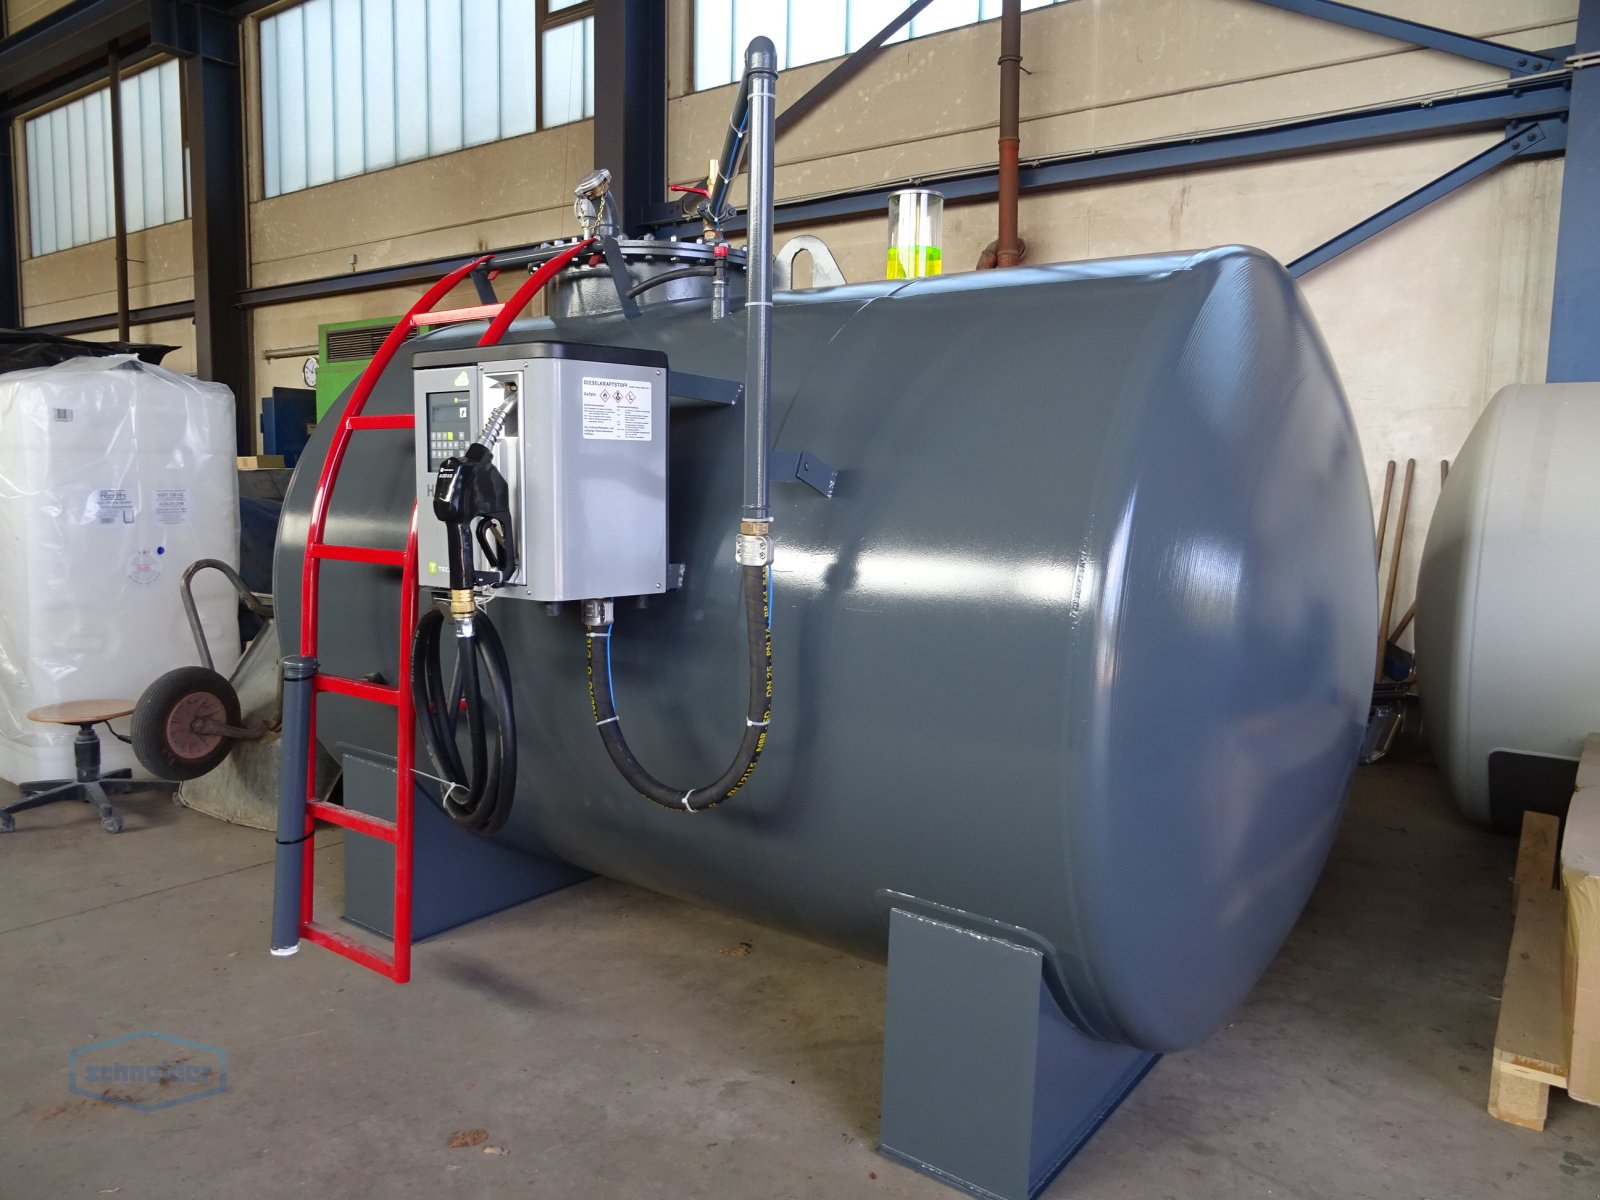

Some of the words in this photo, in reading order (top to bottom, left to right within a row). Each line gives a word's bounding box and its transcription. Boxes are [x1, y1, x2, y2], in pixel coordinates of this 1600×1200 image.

[584, 380, 628, 388] DIESELKRAFTSTOFF
[100, 491, 126, 499] Roth
[765, 642, 772, 657] PN
[766, 666, 772, 679] 25
[766, 681, 772, 698] DN
[756, 733, 767, 752] NBR
[738, 762, 756, 785] 12115
